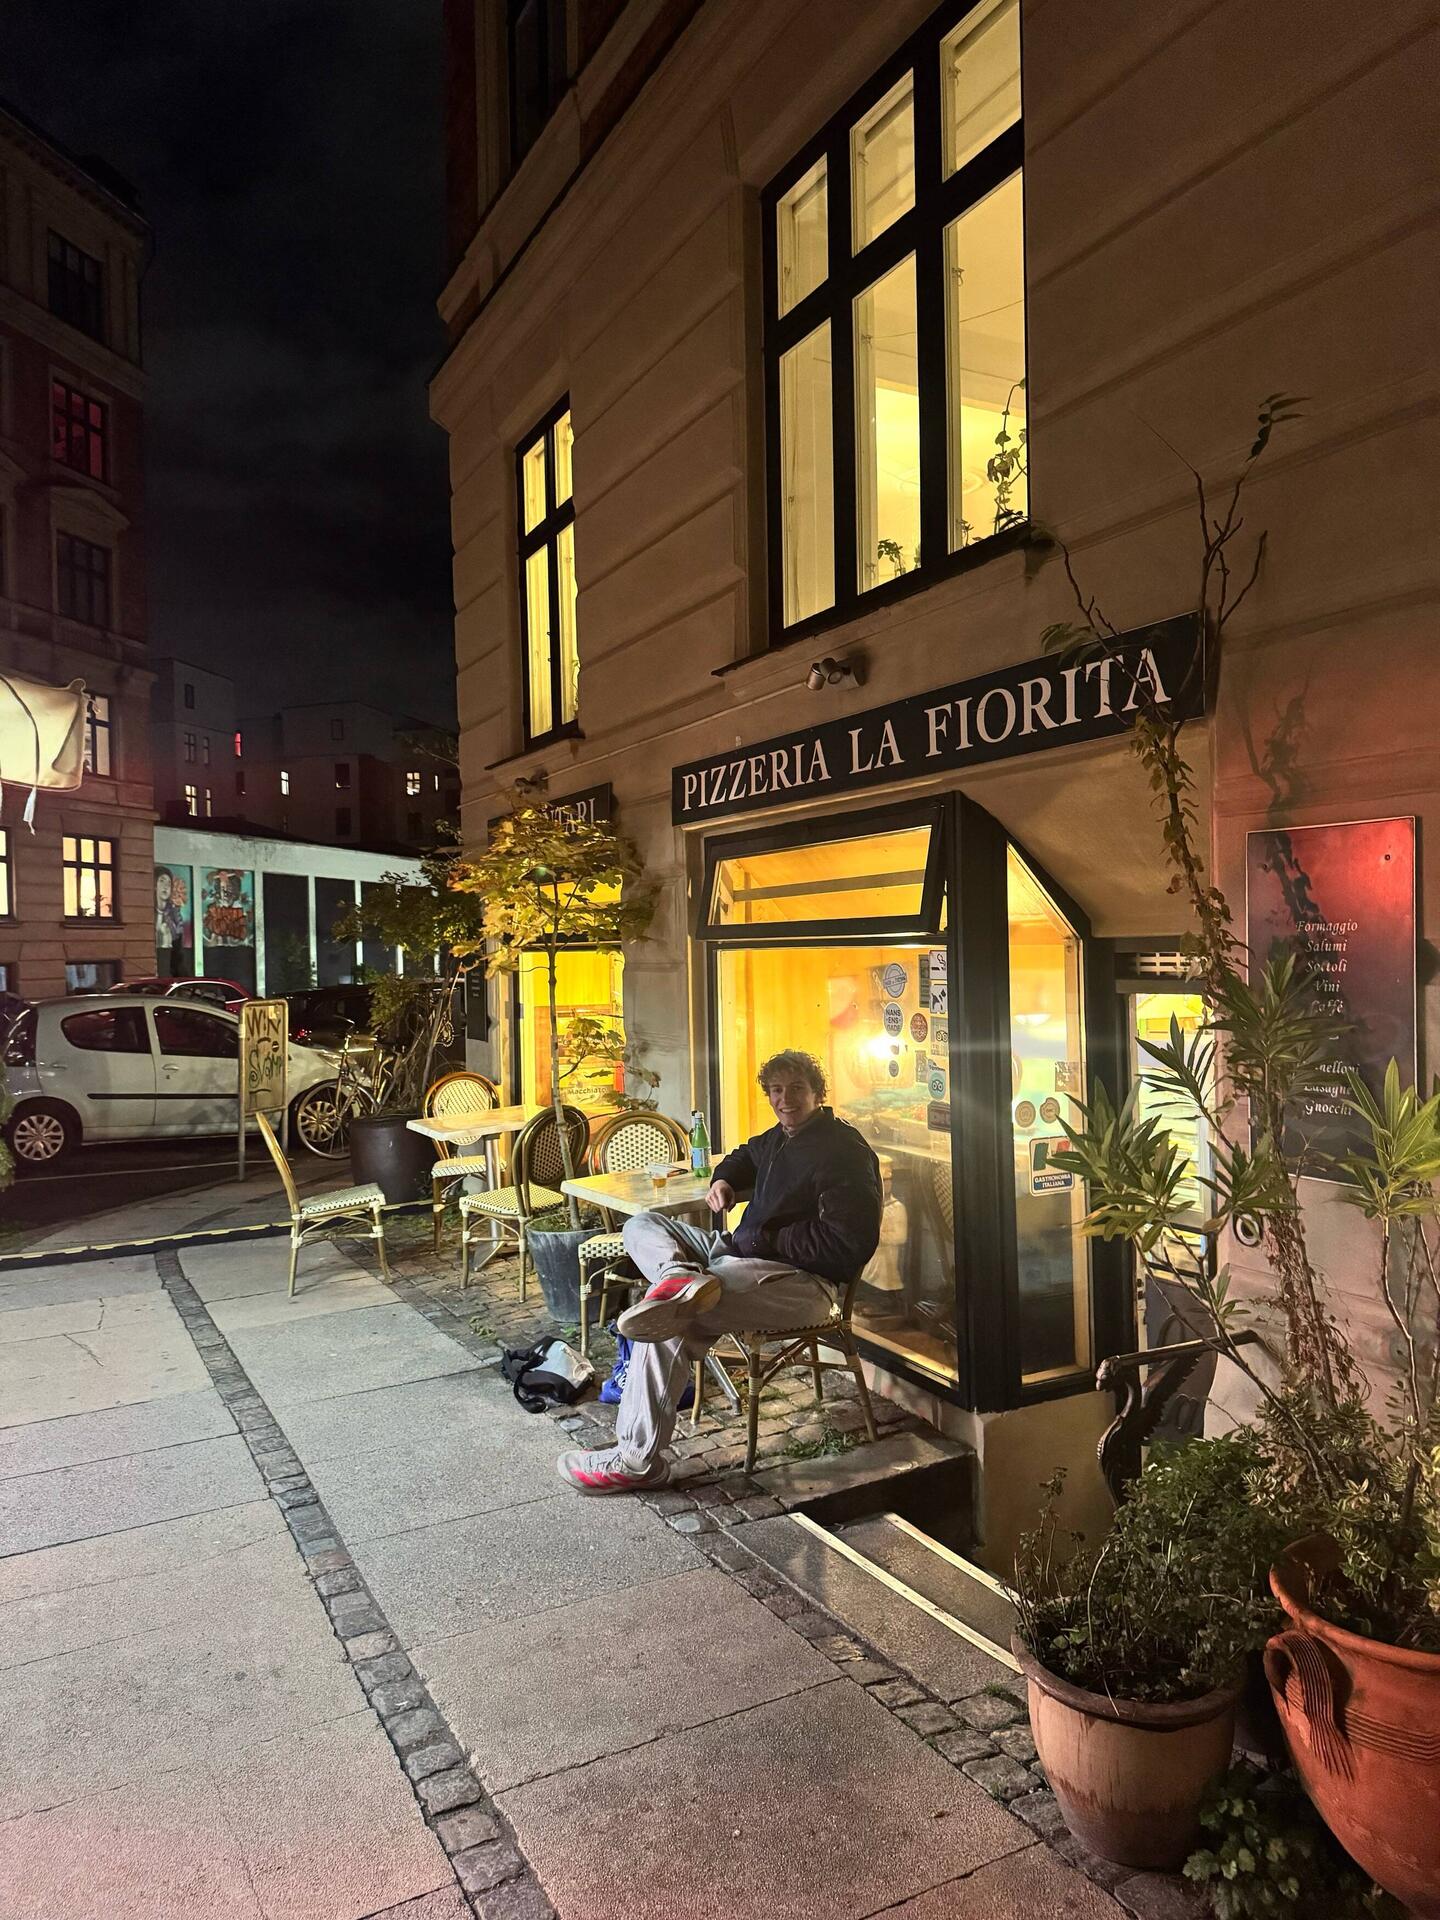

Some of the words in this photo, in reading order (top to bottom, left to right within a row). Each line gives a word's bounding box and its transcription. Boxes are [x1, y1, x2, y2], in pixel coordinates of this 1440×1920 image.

[682, 738, 833, 812] PIZZERIA
[848, 719, 904, 773] LA
[924, 648, 1172, 757] FIORITA
[1295, 918, 1359, 936] Formaggio
[1304, 938, 1348, 953] Salumi
[1313, 978, 1341, 993] Vini
